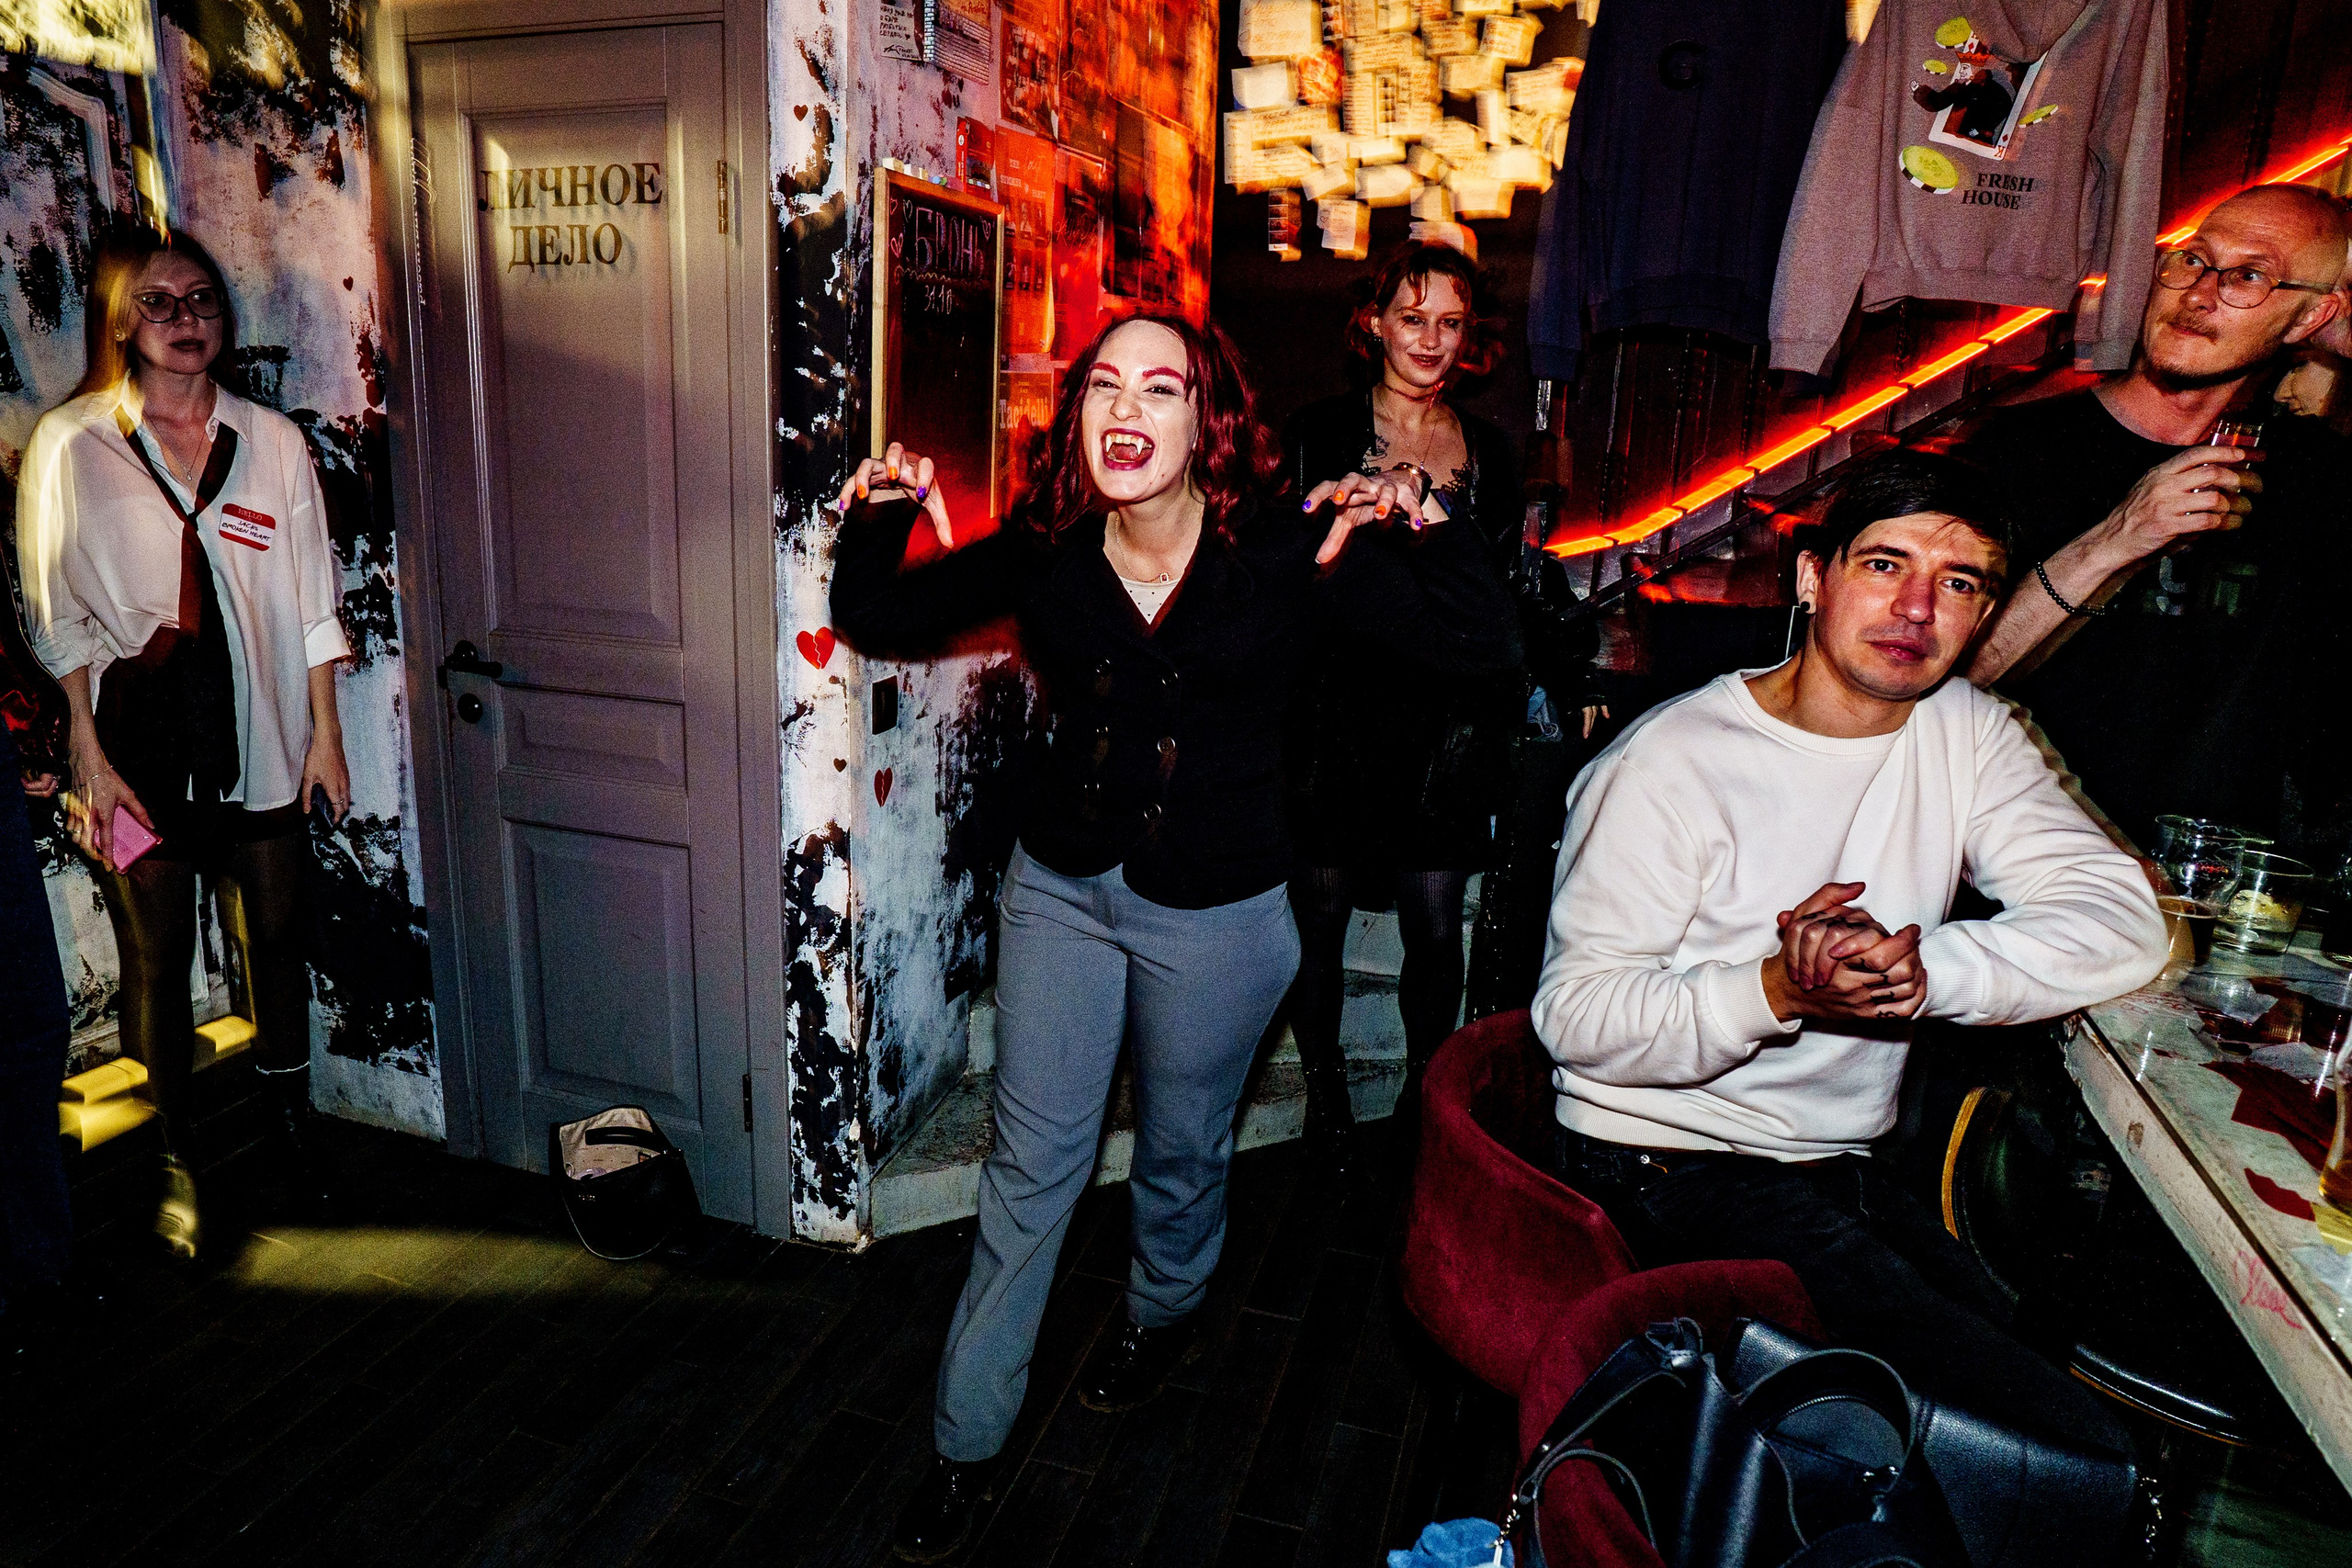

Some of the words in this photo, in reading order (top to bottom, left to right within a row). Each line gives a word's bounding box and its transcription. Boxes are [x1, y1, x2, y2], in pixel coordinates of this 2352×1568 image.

[478, 163, 662, 212] ЛИЧНОЕ
[1976, 173, 2035, 192] FRESH
[1962, 189, 2021, 210] HOUSE
[507, 222, 623, 274] ДЕЛО
[915, 207, 985, 279] БРОНЬ
[238, 508, 263, 521] HELLO
[221, 523, 249, 533] BROKEN
[249, 532, 271, 541] HEART
